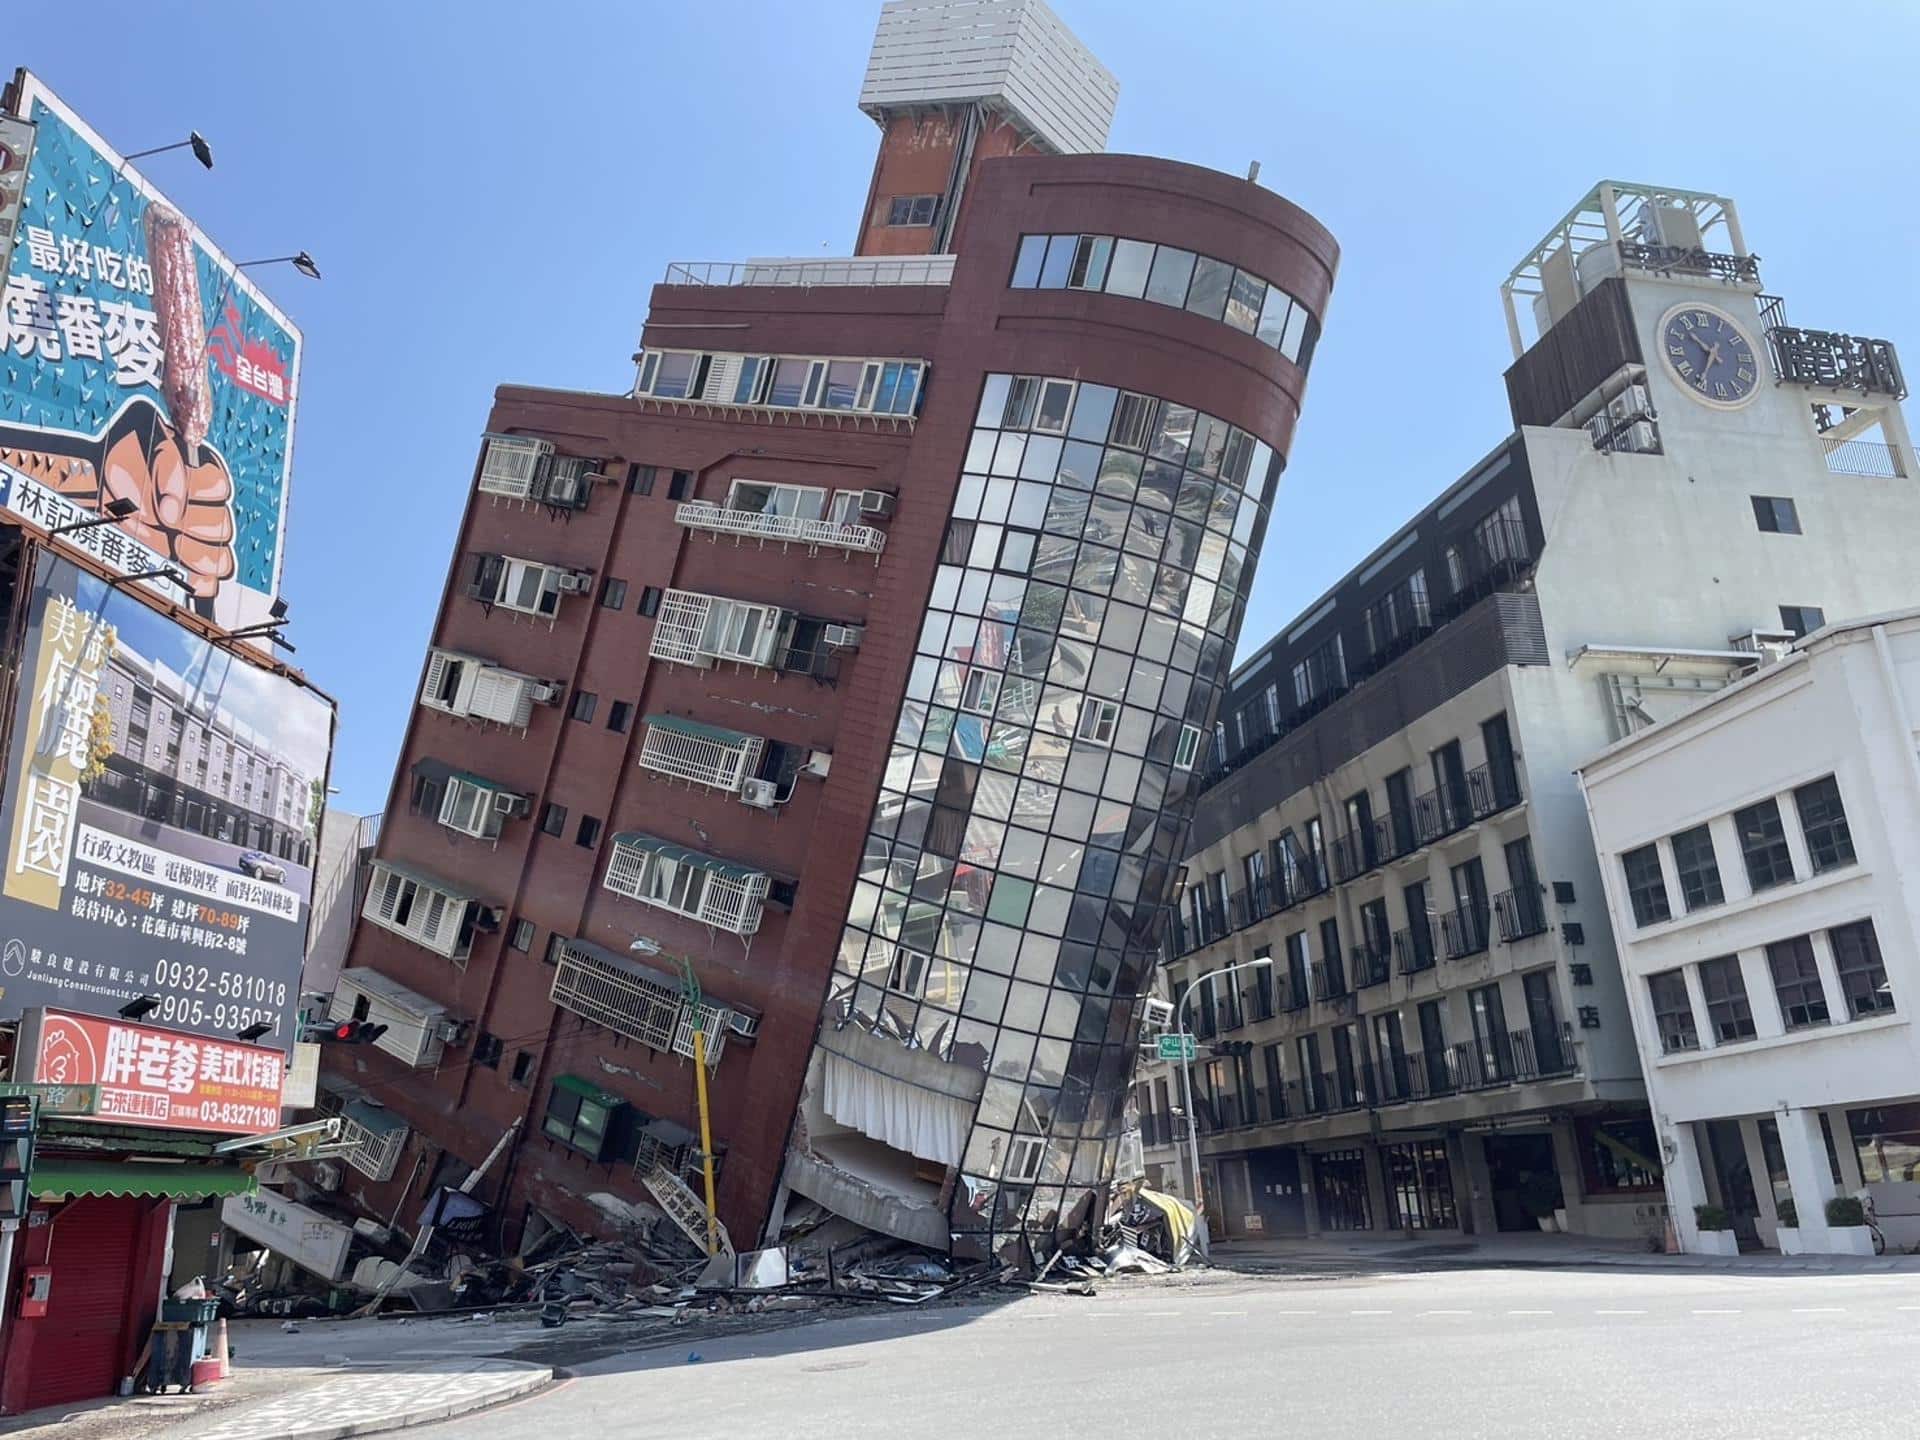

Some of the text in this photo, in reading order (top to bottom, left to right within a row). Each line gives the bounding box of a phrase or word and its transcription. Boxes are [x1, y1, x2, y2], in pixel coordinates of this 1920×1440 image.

[27, 225, 154, 295] 最好吃的
[16, 480, 151, 574] 林記燒番麥
[83, 833, 156, 875] 行政文教區
[165, 861, 218, 893] 電梯別墅
[75, 870, 250, 935] 地坪32-45坪 建坪70-89坪
[155, 959, 286, 1006] 0932-581018
[102, 1025, 280, 1094] 胖老爹 美式炸雞
[200, 1101, 277, 1127] 03-8327130
